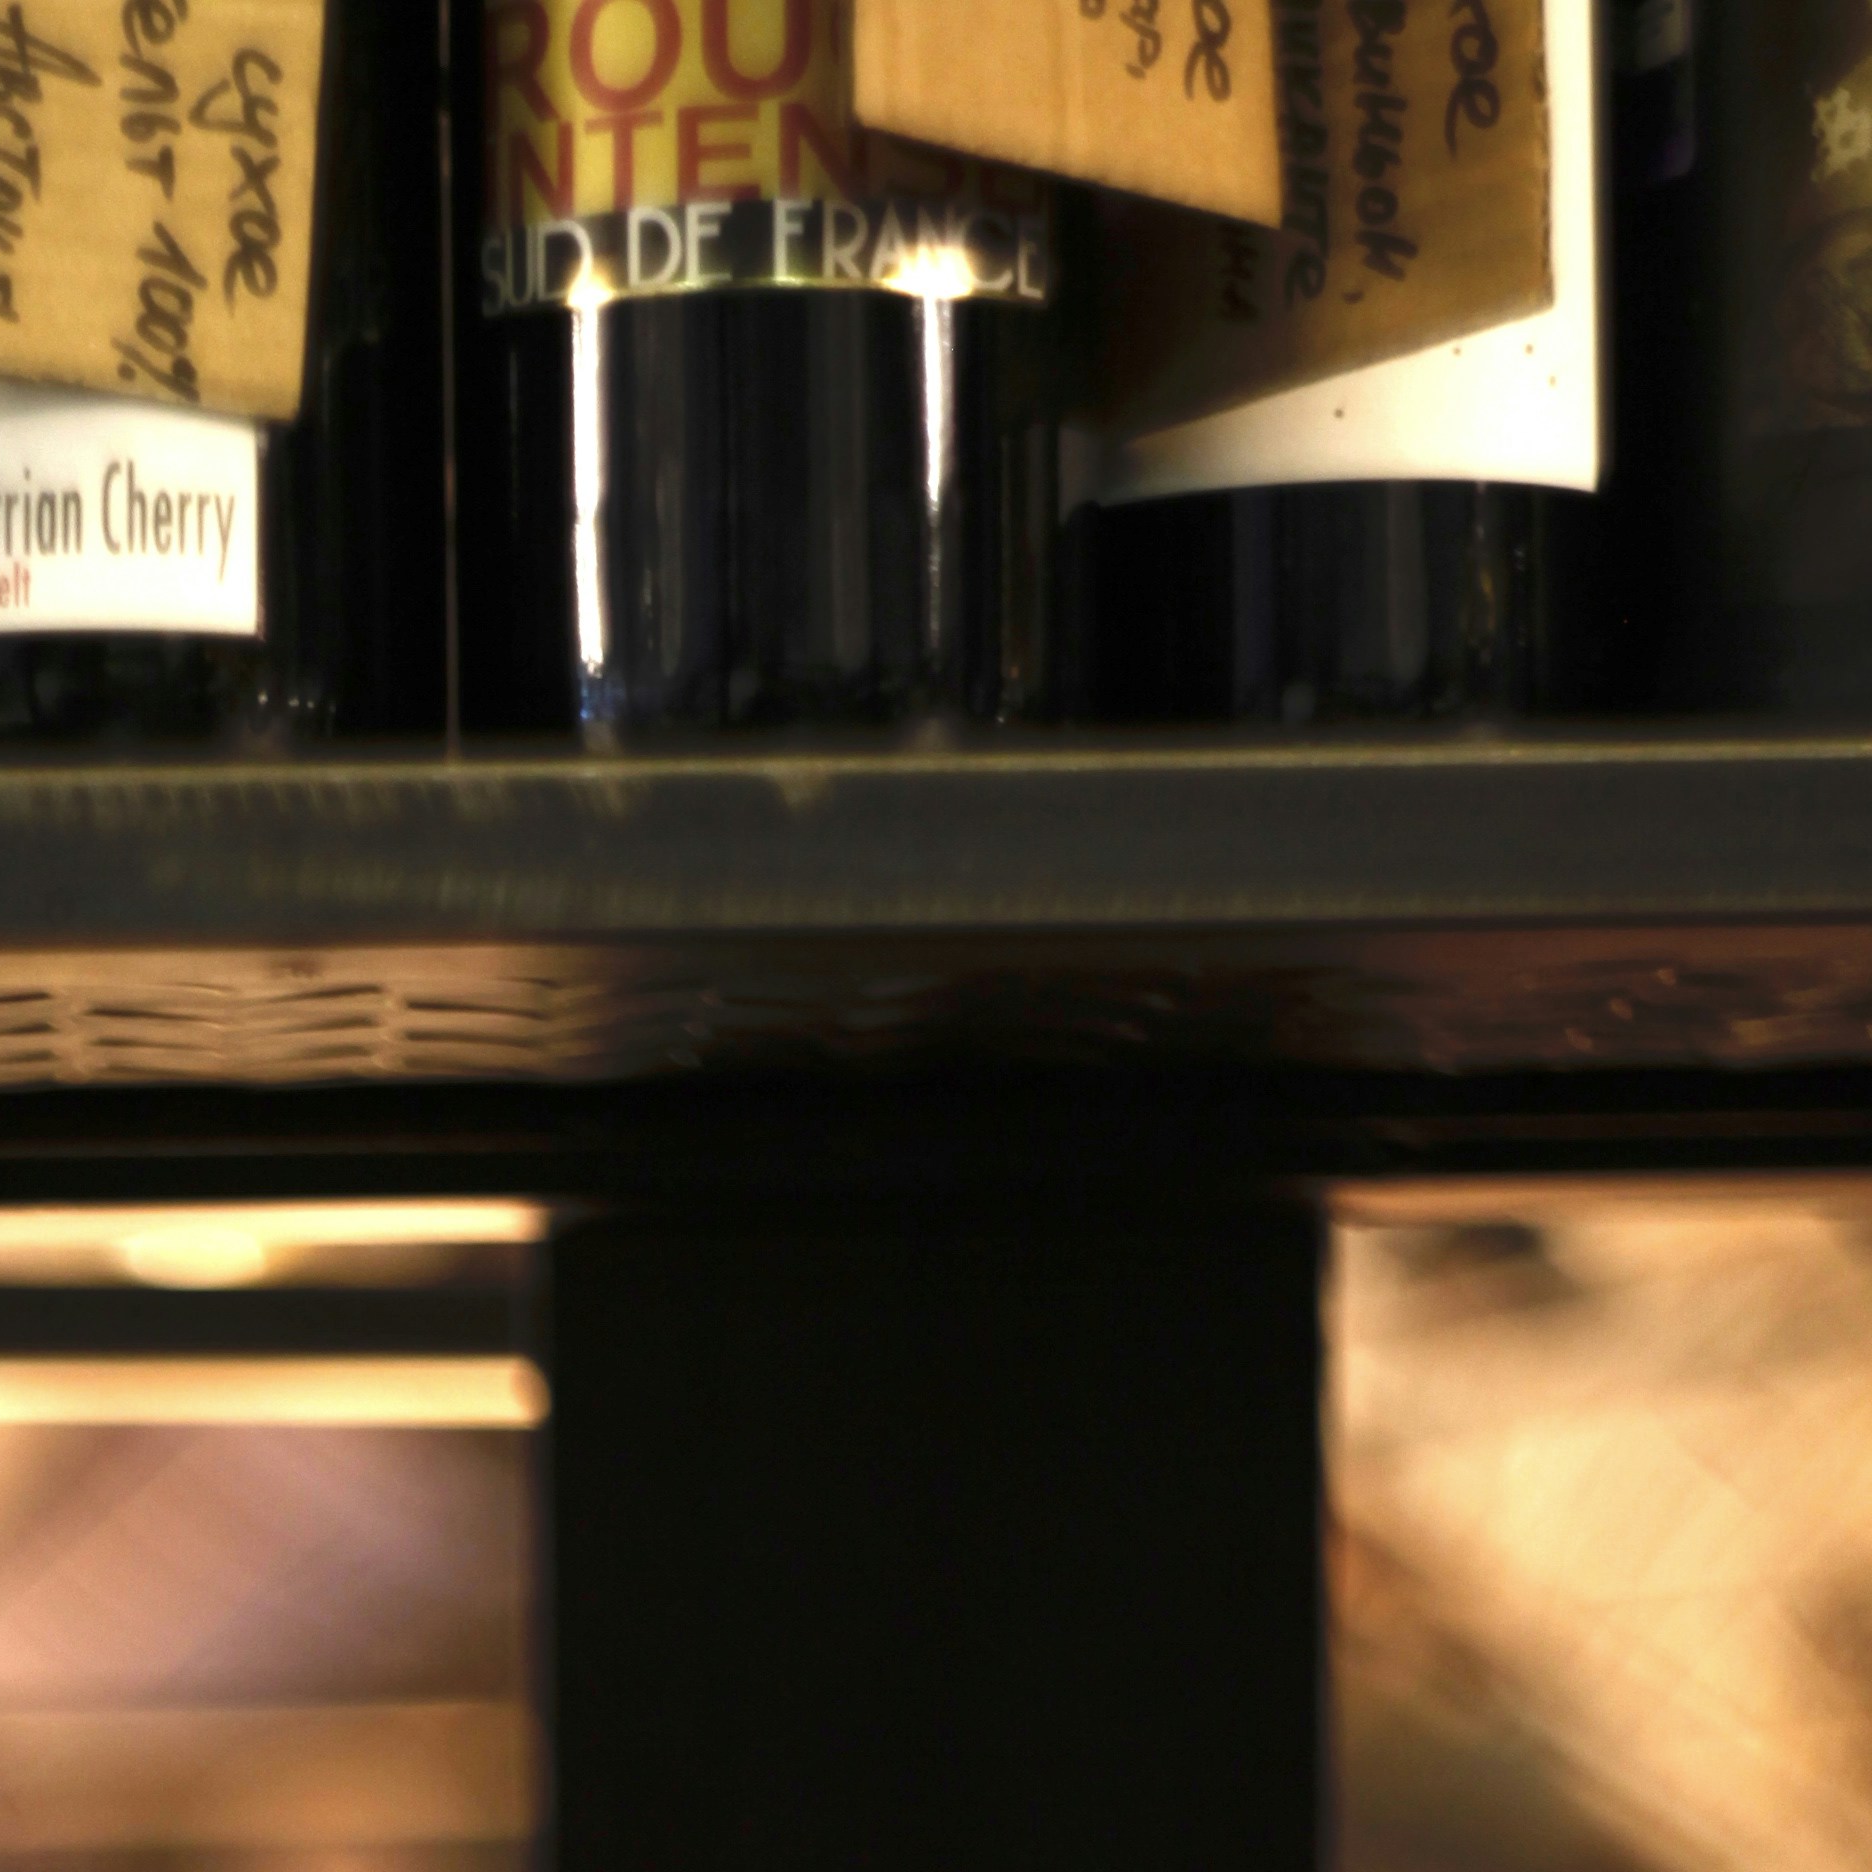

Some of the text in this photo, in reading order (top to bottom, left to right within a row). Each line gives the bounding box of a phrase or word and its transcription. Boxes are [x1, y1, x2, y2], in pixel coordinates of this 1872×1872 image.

[484, 0, 854, 122] ROU
[188, 46, 284, 316] сухое
[112, 220, 210, 402] 100%
[628, 201, 734, 291] DE
[773, 199, 1046, 300] FRANCE
[99, 457, 235, 584] Cherry
